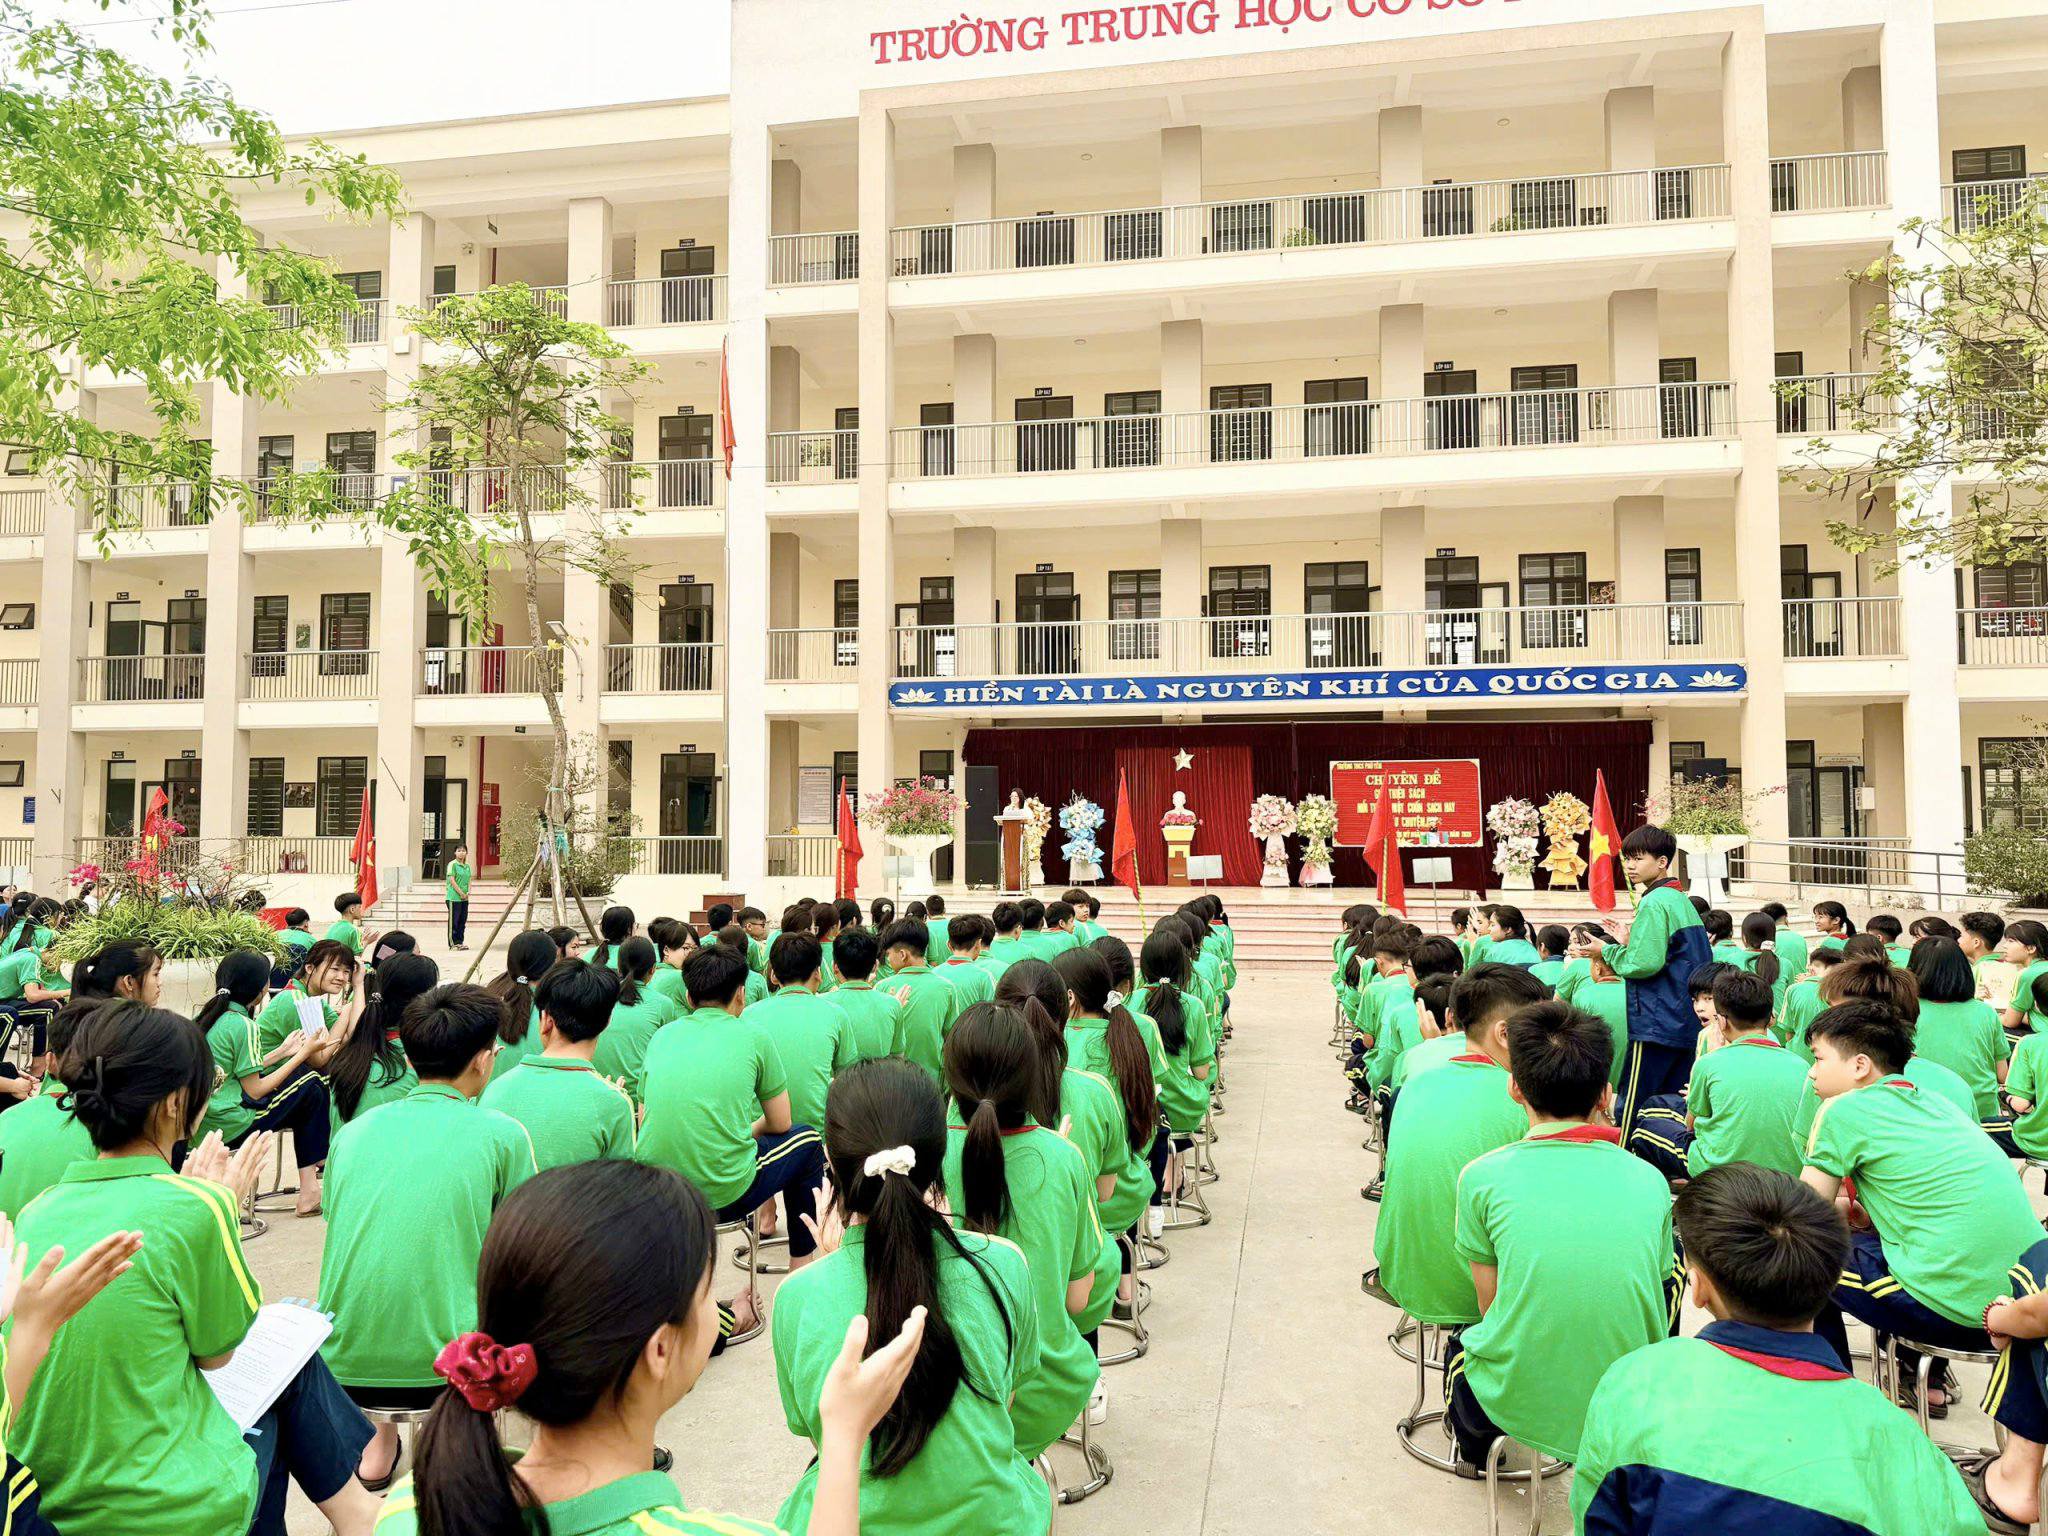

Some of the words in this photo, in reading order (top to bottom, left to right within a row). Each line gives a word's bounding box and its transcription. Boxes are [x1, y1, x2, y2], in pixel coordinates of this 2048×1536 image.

[871, 13, 1049, 64] TRƯỜNG
[1062, 0, 1219, 45] TRUNG
[1235, 0, 1333, 33] HỌC
[943, 680, 1024, 703] HIỀN
[1033, 679, 1093, 701] TÀI
[1103, 678, 1147, 700] LÀ
[1157, 676, 1310, 699] NGUYÊN
[1320, 673, 1389, 696] KHÍ
[1397, 671, 1479, 694] CỦA
[1488, 668, 1597, 694] QUỐC
[1605, 672, 1680, 690] GIA
[1424, 768, 1441, 785] ĐỀ
